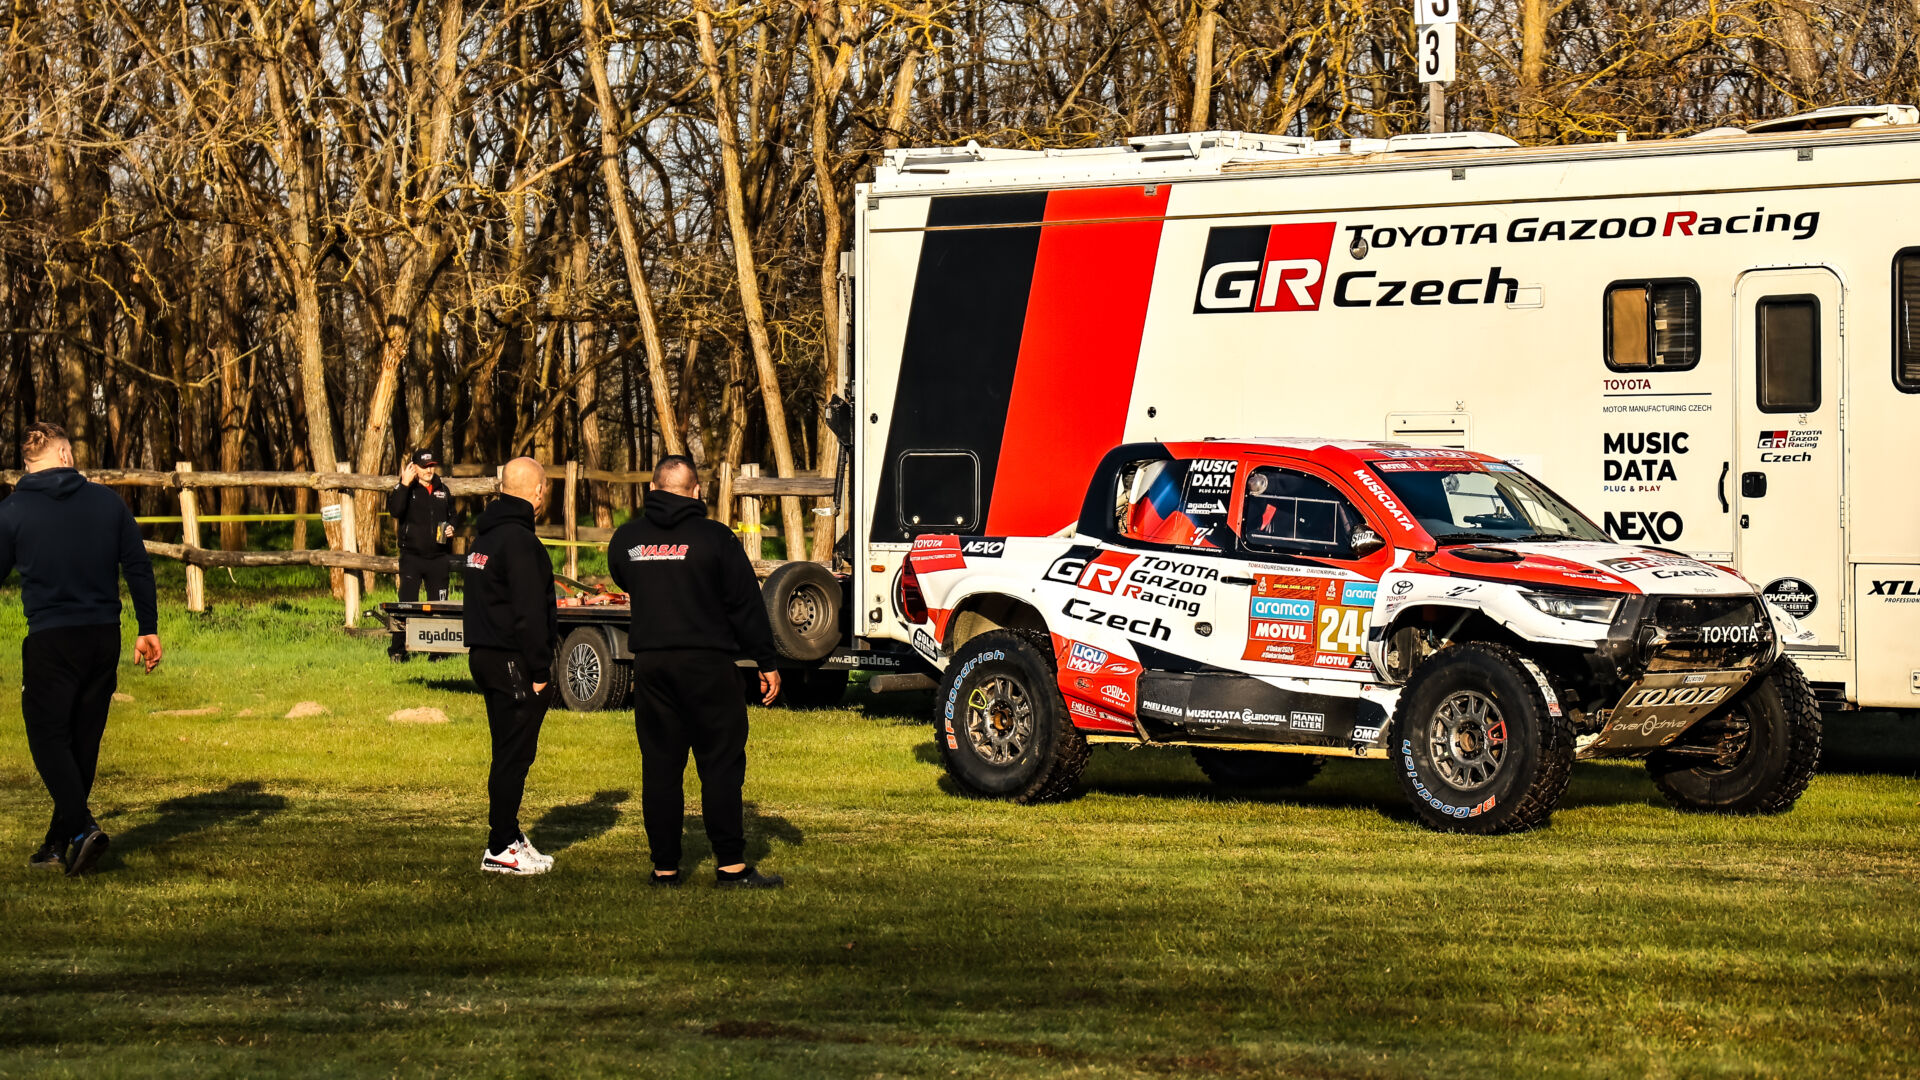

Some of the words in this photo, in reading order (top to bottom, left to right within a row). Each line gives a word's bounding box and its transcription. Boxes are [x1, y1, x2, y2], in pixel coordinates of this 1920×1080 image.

[1426, 30, 1439, 75] 3
[1345, 222, 1497, 249] TOYOTA
[1506, 216, 1657, 243] GAZOO
[1662, 206, 1820, 241] Racing
[1200, 258, 1322, 309] GR
[1333, 266, 1519, 307] Czech
[1603, 379, 1651, 390] TOYOTA
[1603, 405, 1628, 413] MOTOR
[1688, 404, 1712, 412] CZECH
[1604, 431, 1689, 454] MUSIC
[1758, 438, 1785, 448] GR
[1760, 452, 1812, 463] Czech
[1190, 460, 1239, 473] MUSIC
[1604, 459, 1677, 481] DATA
[1192, 473, 1231, 487] DATA
[1187, 502, 1217, 510] agados
[1353, 469, 1414, 531] MUSICDATA
[1604, 511, 1683, 544] NEXO
[641, 544, 689, 556] VASAS
[914, 539, 943, 548] TOYOTA
[962, 541, 1004, 554] NEXO
[1048, 557, 1122, 594] GR
[1142, 556, 1219, 581] TOYOTA
[1652, 569, 1719, 579] Czech
[1130, 569, 1207, 596] GAZOO
[1867, 580, 1920, 595] XTL
[1122, 584, 1200, 617] Racing
[1345, 589, 1377, 600] aramc
[1255, 601, 1310, 617] aramco
[1061, 597, 1172, 641] Czech
[418, 628, 463, 644] agados
[1255, 622, 1307, 640] MOTUL
[1703, 625, 1759, 643] TOYOTA
[1073, 644, 1107, 664] LIQUI
[1317, 655, 1350, 666] MOTUL
[1069, 657, 1101, 672] MOLY
[944, 649, 1005, 750] BFGoodrich
[1105, 685, 1127, 700] PRIM
[1625, 686, 1731, 707] TOYOTA
[1071, 701, 1097, 714] ENDLESS
[1142, 700, 1161, 710] PNEU
[1161, 705, 1183, 716] KAFKA
[1186, 709, 1241, 719] MUSICDATA
[1293, 714, 1322, 722] MANN
[1293, 720, 1321, 729] FILTER
[1354, 728, 1380, 740] OMP
[1402, 739, 1496, 819] BFGoodrich
